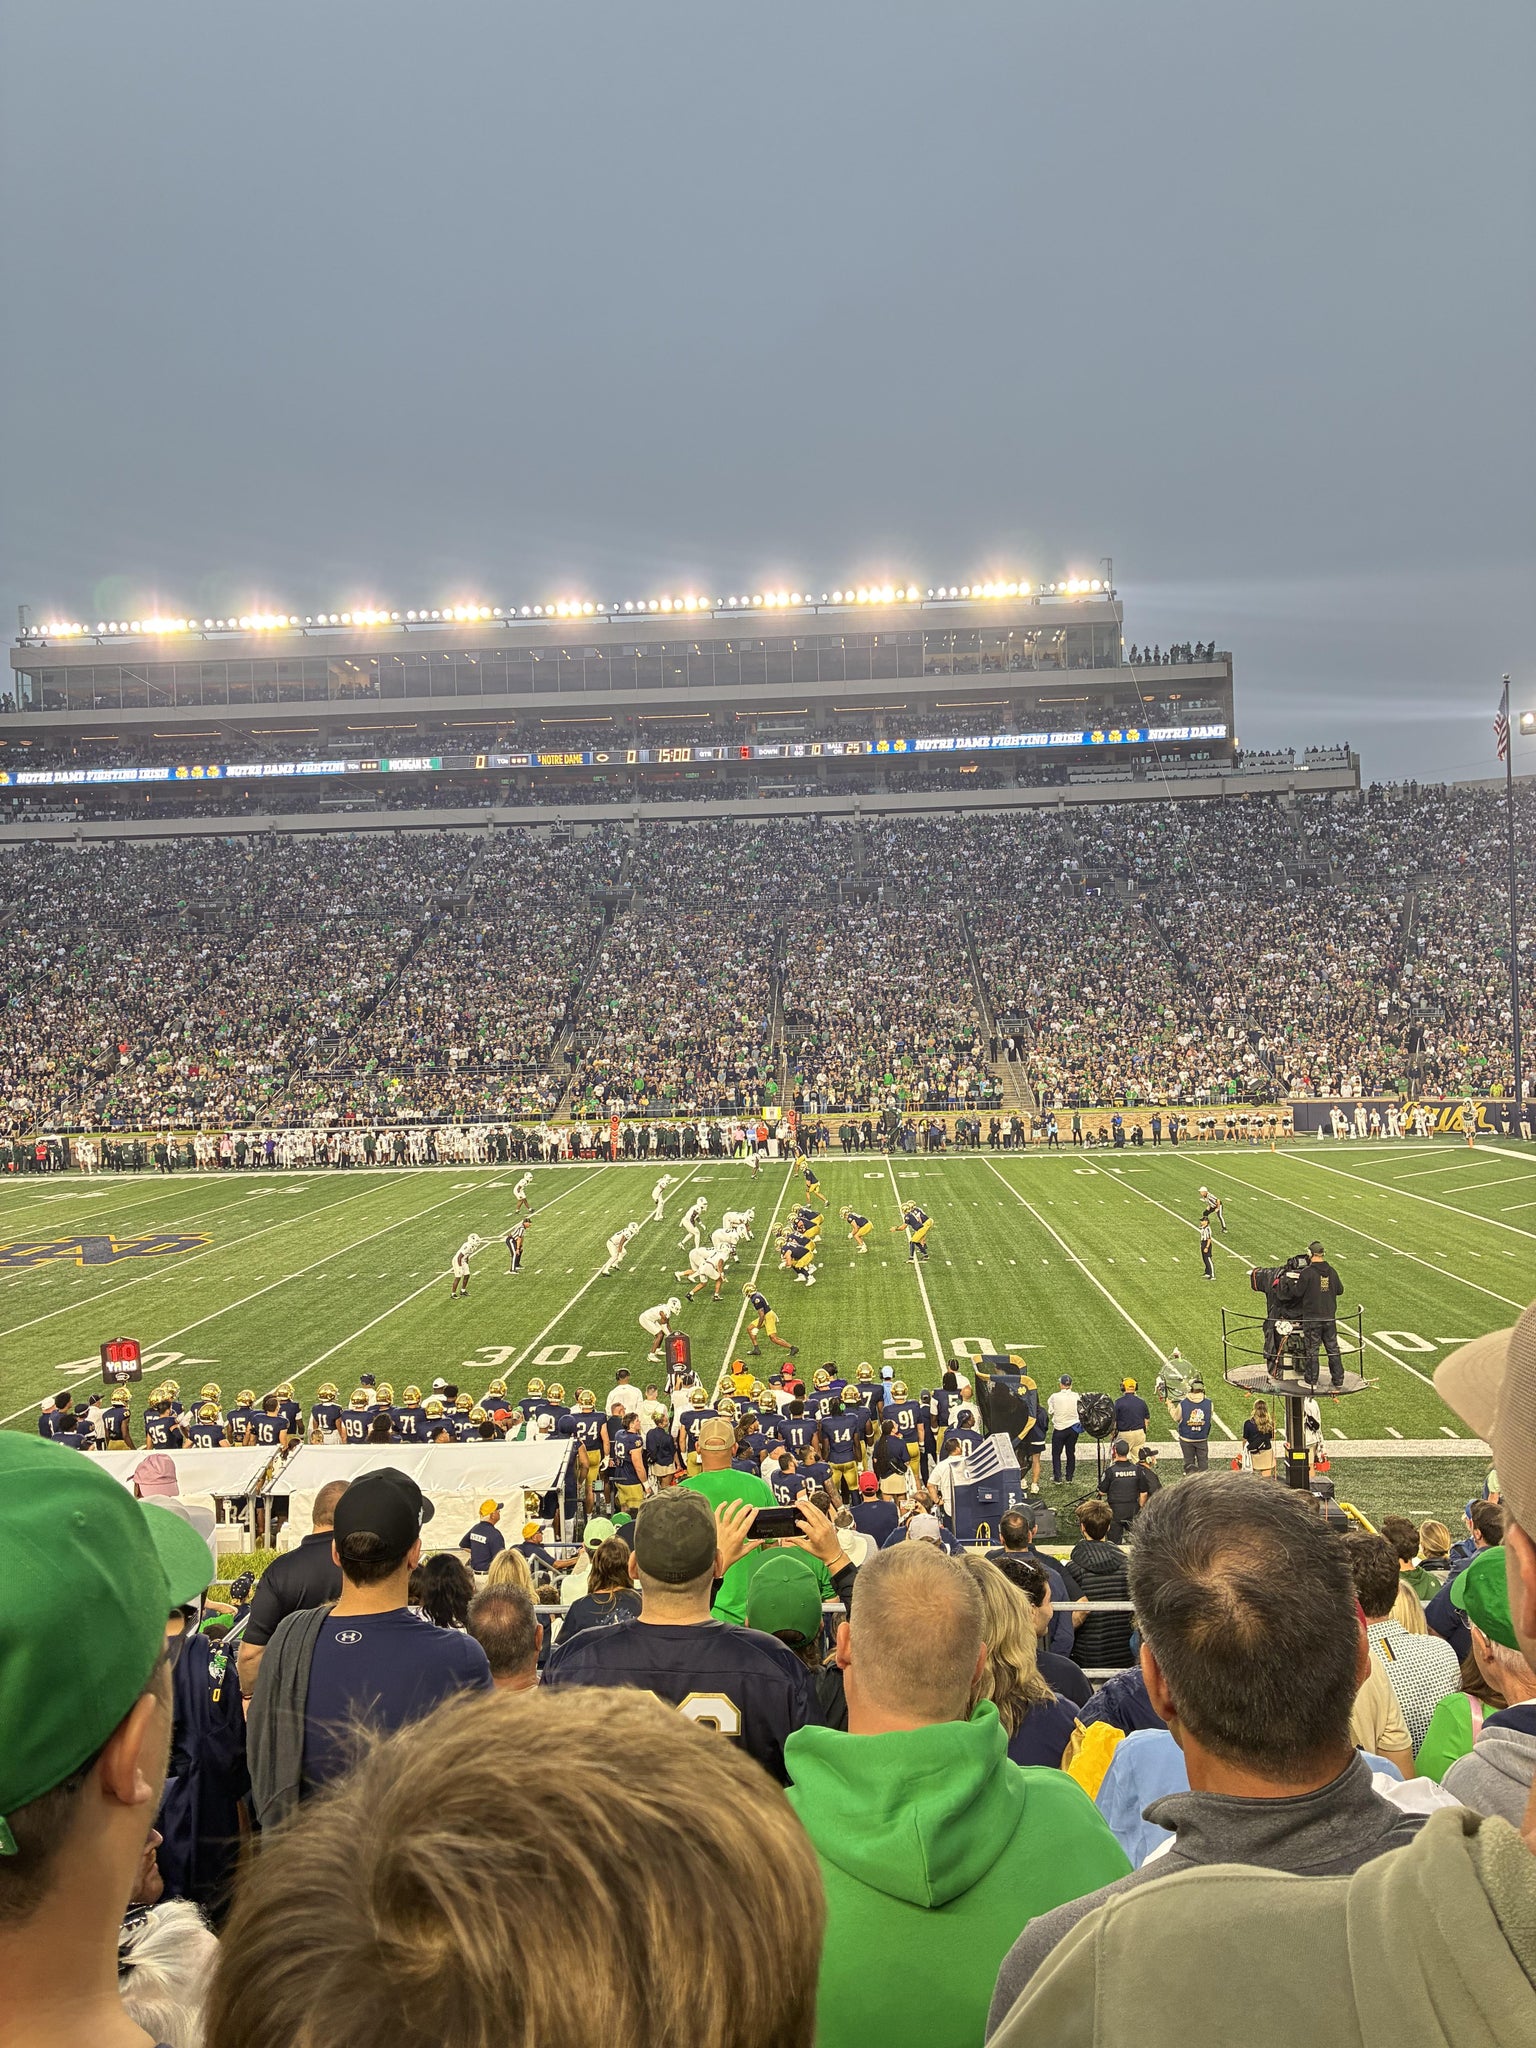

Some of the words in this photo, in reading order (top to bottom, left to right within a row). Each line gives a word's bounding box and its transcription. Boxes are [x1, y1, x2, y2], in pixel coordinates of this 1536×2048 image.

[1147, 728, 1190, 740] NOTRE
[759, 748, 778, 756] DOWN
[811, 744, 822, 755] 10
[846, 743, 860, 755] 25
[915, 739, 954, 751] NOTRE
[475, 755, 486, 769] 0
[542, 754, 563, 765] NOTRE
[564, 753, 583, 765] DAME
[627, 750, 637, 764] 0
[659, 748, 691, 763] 15:00
[389, 759, 420, 770] MICHIGAN
[107, 1343, 137, 1362] 10
[462, 1344, 583, 1367] 30
[673, 1339, 686, 1364] 1
[882, 1337, 998, 1359] 20
[106, 1360, 137, 1372] YARD
[105, 1417, 115, 1431] 17
[232, 1417, 246, 1433] 15
[317, 1413, 328, 1429] 11
[400, 1415, 416, 1434] 71
[898, 1409, 915, 1430] 91
[148, 1424, 167, 1444] 35
[257, 1422, 273, 1443] 16
[345, 1419, 363, 1439] 89
[576, 1421, 598, 1442] 24
[791, 1428, 803, 1445] 11
[834, 1428, 851, 1443] 14
